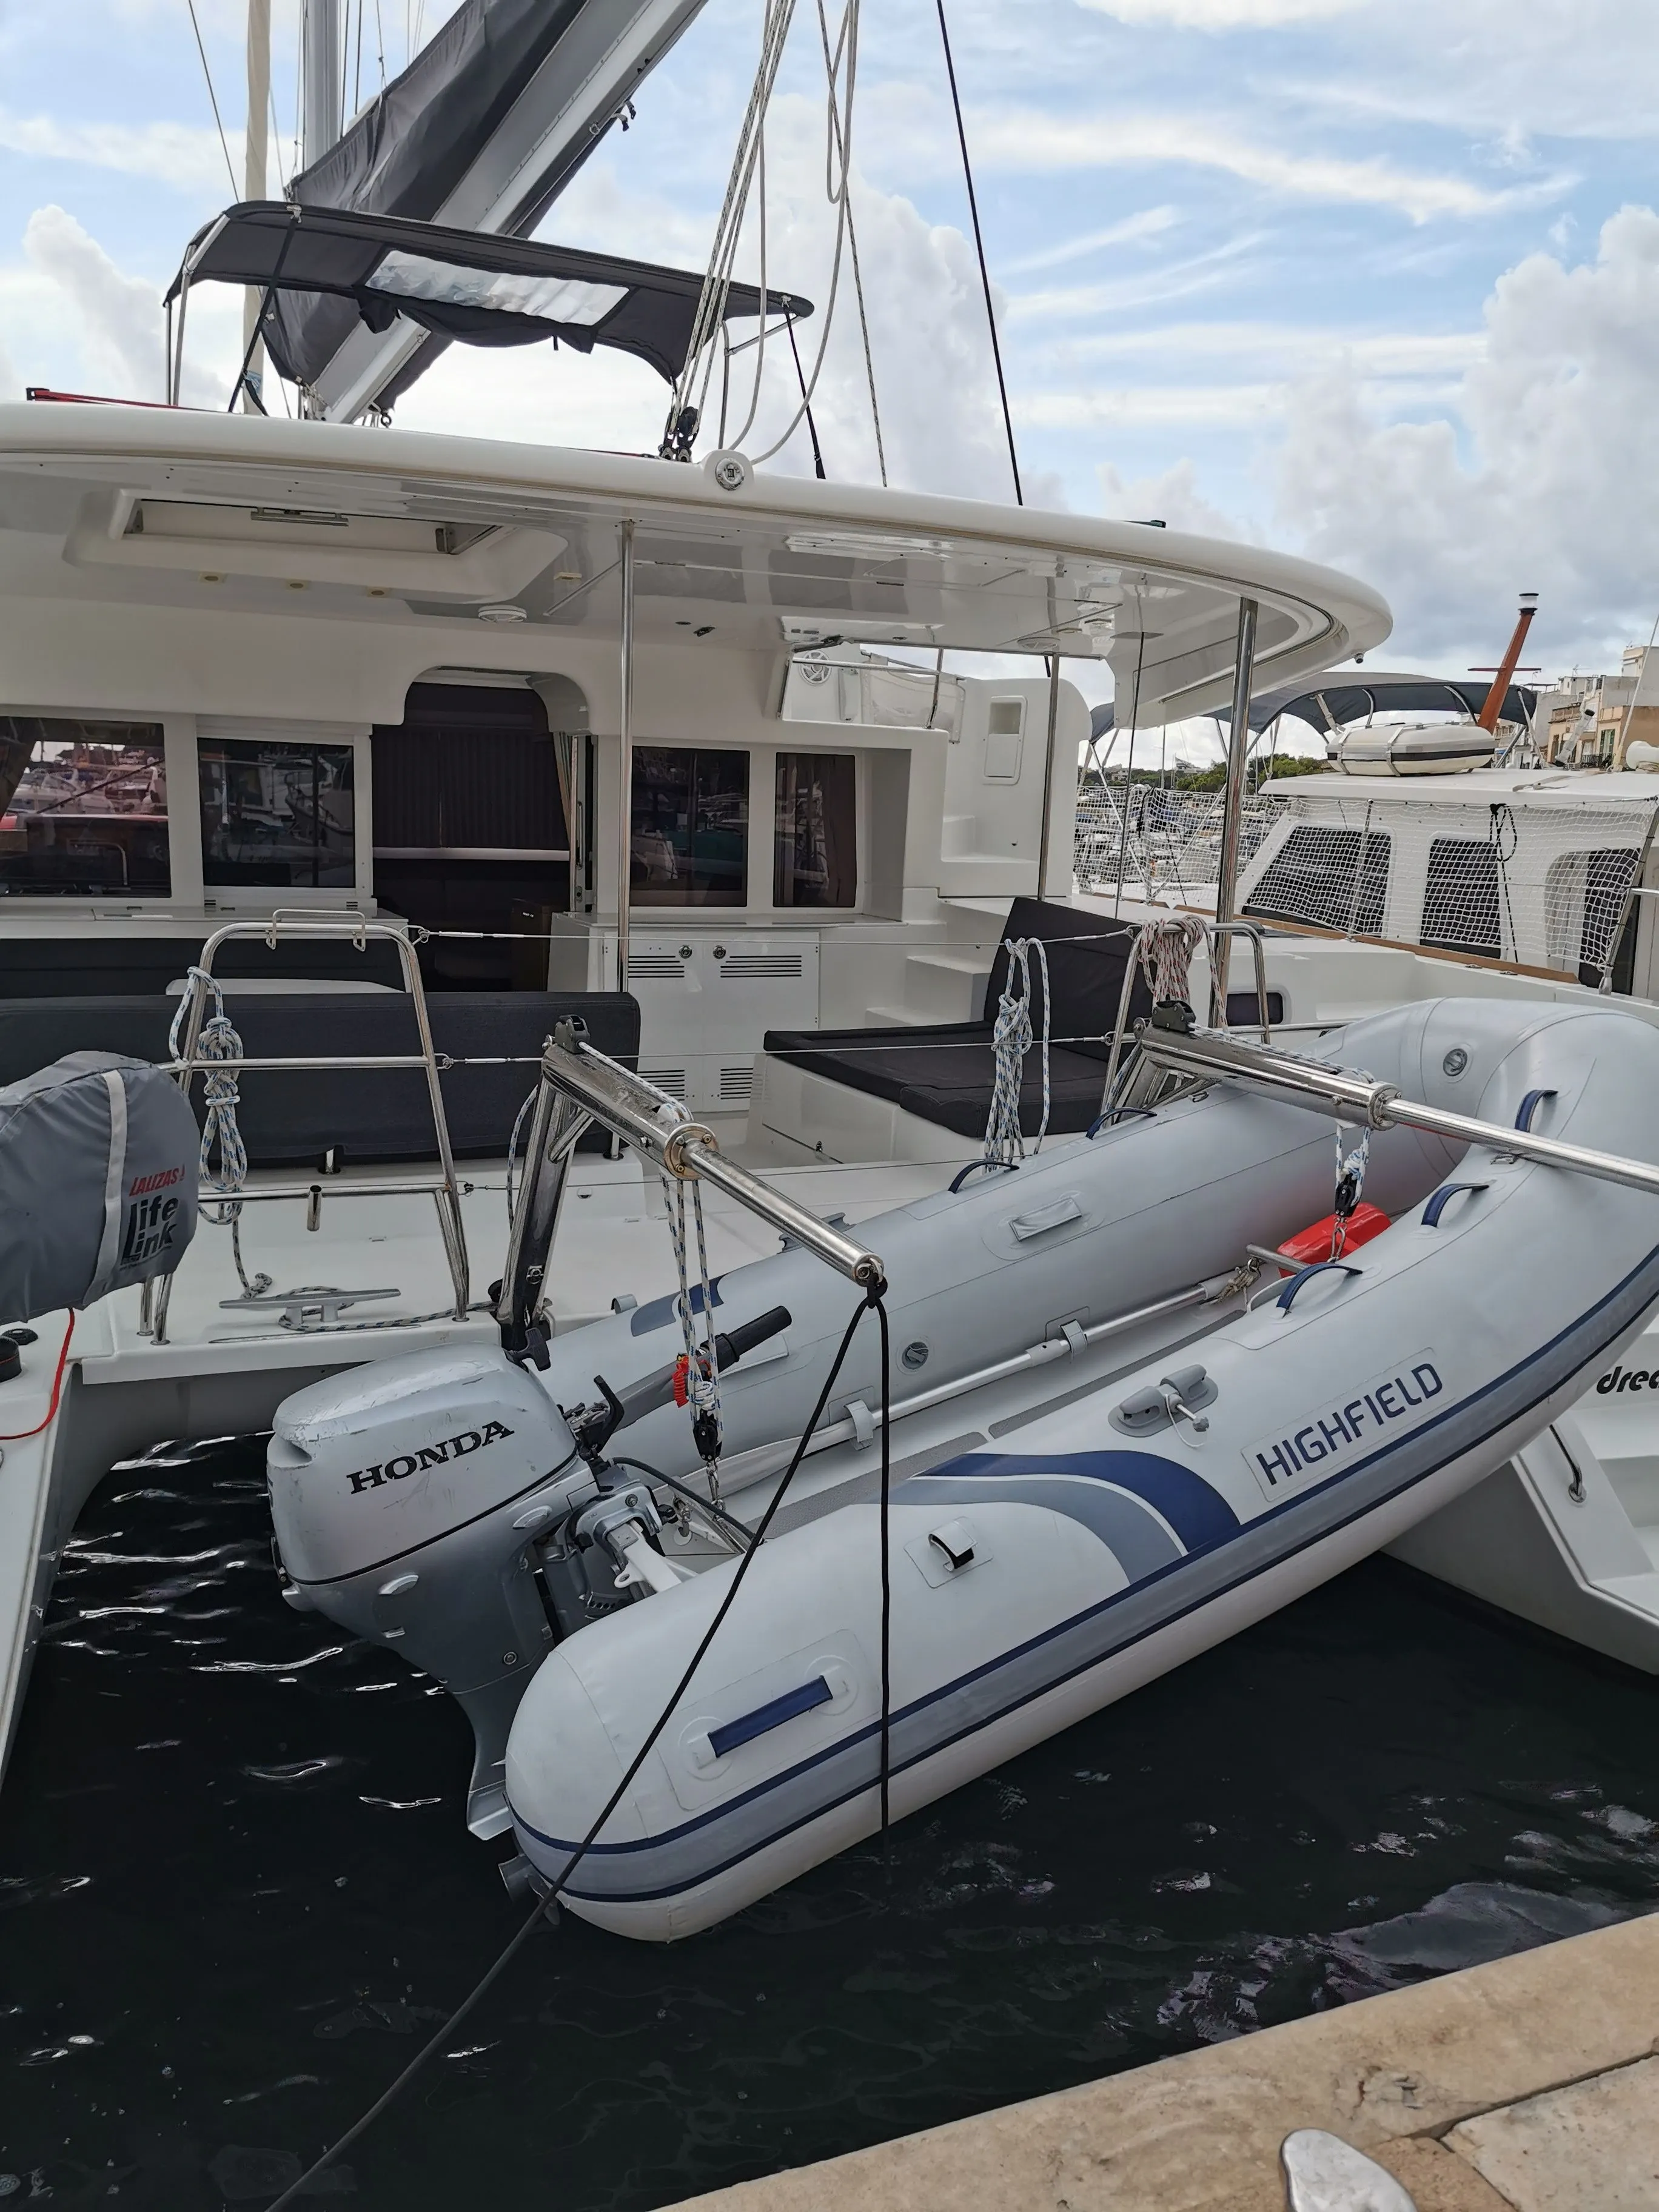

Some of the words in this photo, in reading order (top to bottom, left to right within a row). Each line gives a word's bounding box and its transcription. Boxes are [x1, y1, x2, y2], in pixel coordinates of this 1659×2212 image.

[129, 1168, 179, 1197] LALIZAS
[346, 1421, 515, 1495] HONDA
[1256, 1363, 1443, 1486] HIGHFIELD
